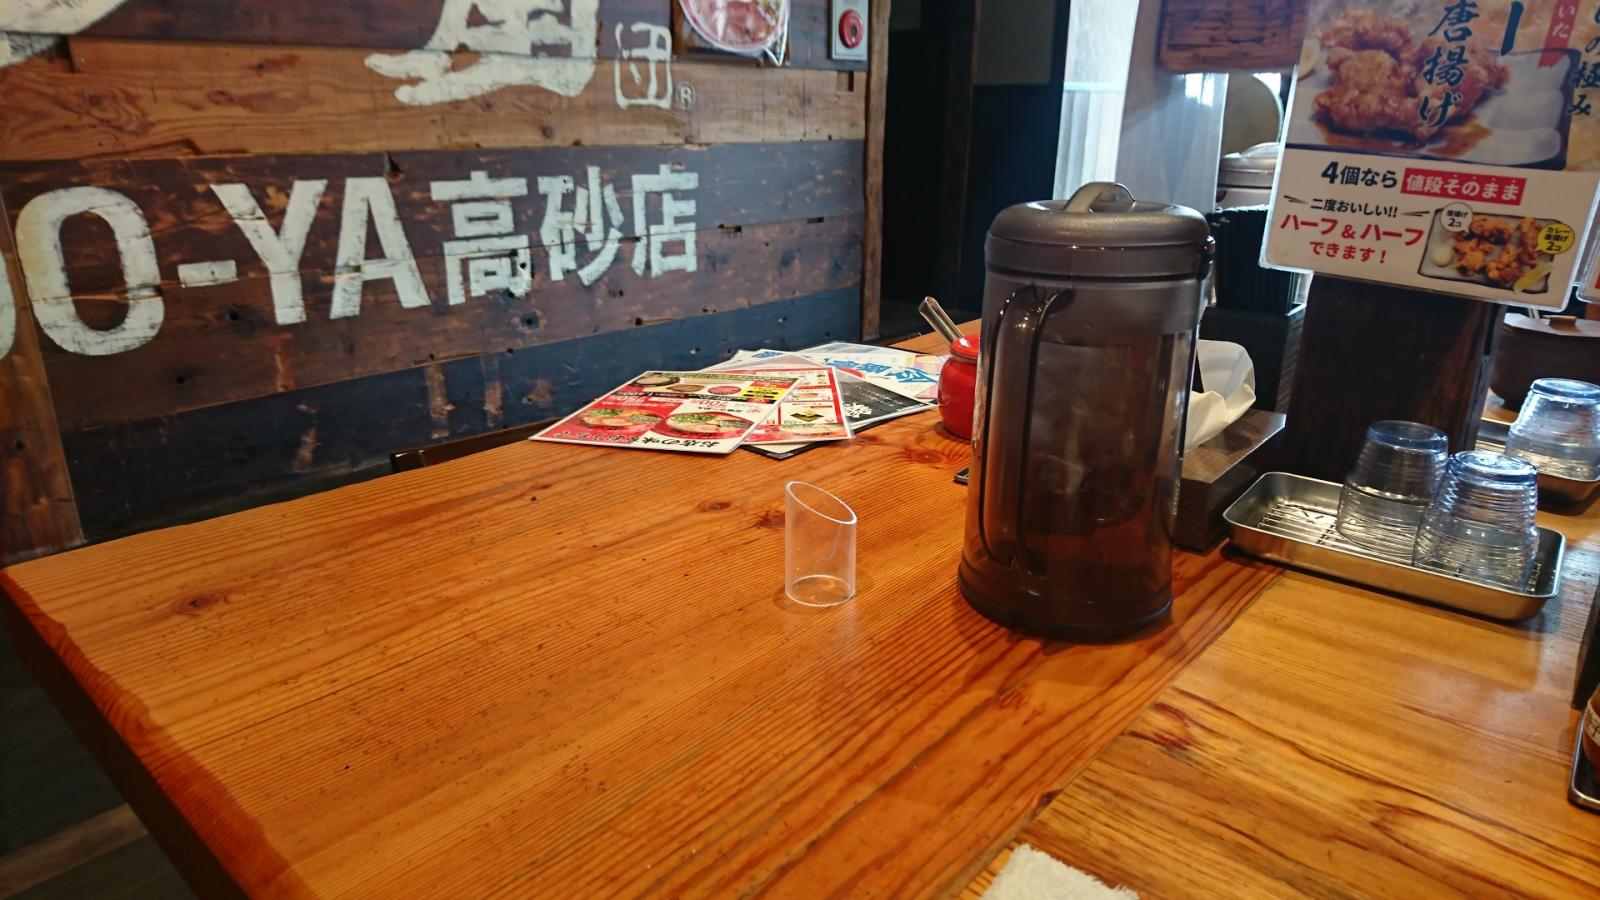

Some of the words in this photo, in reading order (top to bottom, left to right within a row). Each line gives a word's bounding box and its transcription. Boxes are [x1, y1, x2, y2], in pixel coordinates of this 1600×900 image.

[1420, 0, 1479, 128] 唐揚げ
[1569, 5, 1600, 116] の極み
[1321, 161, 1398, 188] 4個なら
[1406, 174, 1519, 200] 値段そのまま
[1310, 198, 1398, 218] 二度おいしい!!
[1309, 241, 1387, 264] できます！
